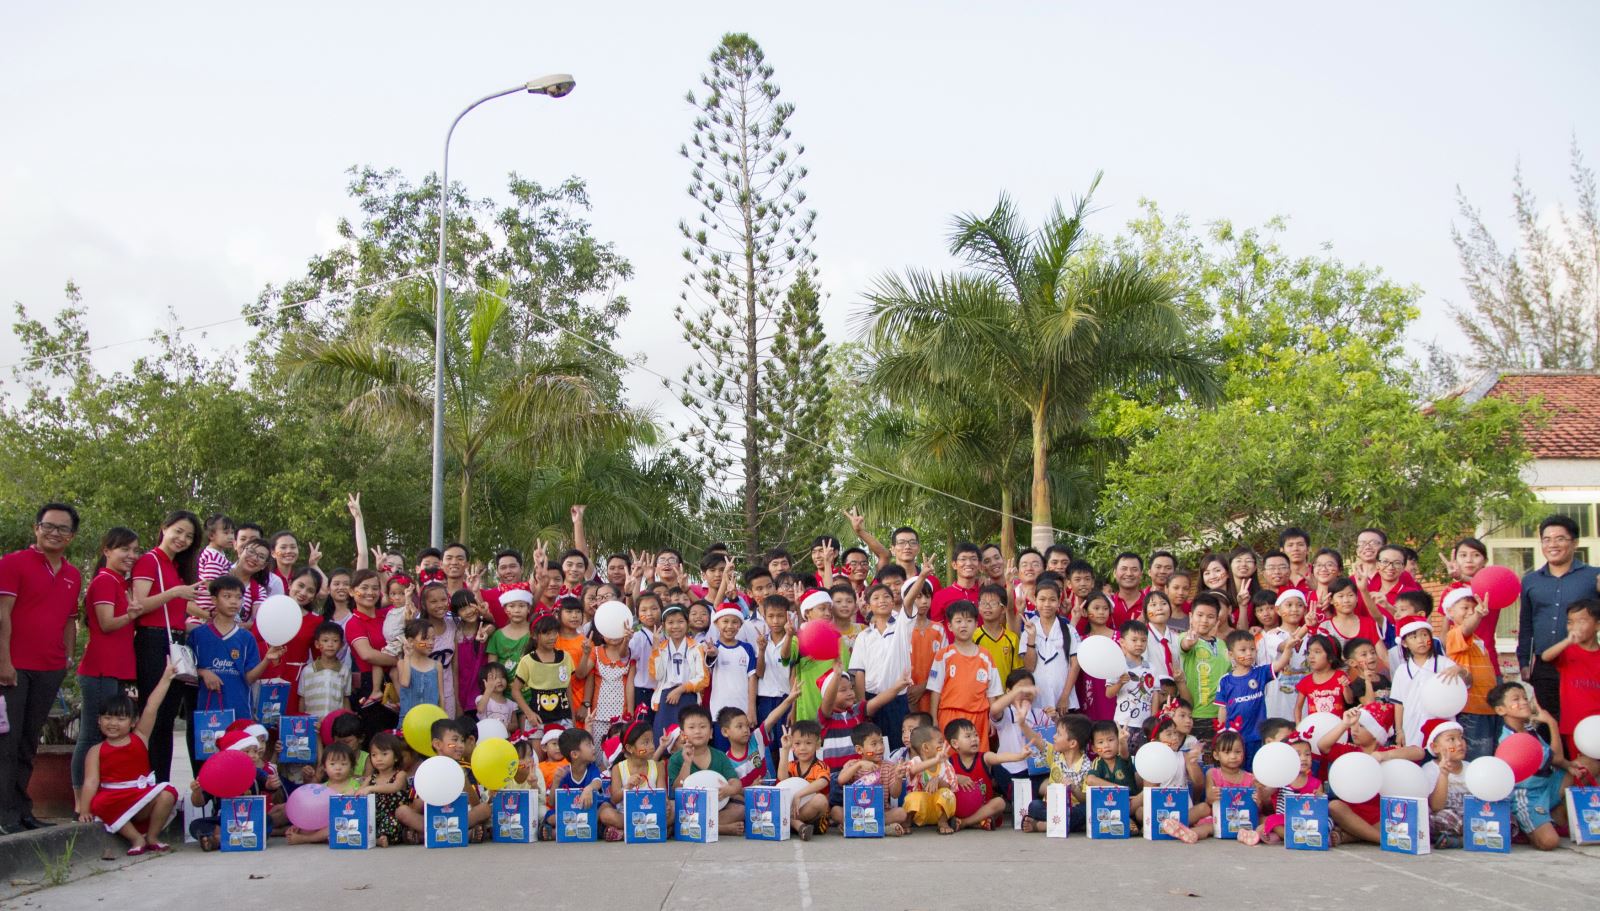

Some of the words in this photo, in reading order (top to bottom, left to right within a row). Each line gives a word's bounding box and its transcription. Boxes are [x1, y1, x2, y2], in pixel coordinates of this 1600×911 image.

[212, 657, 234, 669] Qatar
[949, 664, 957, 678] 8
[1234, 690, 1264, 703] YOKOHAMA
